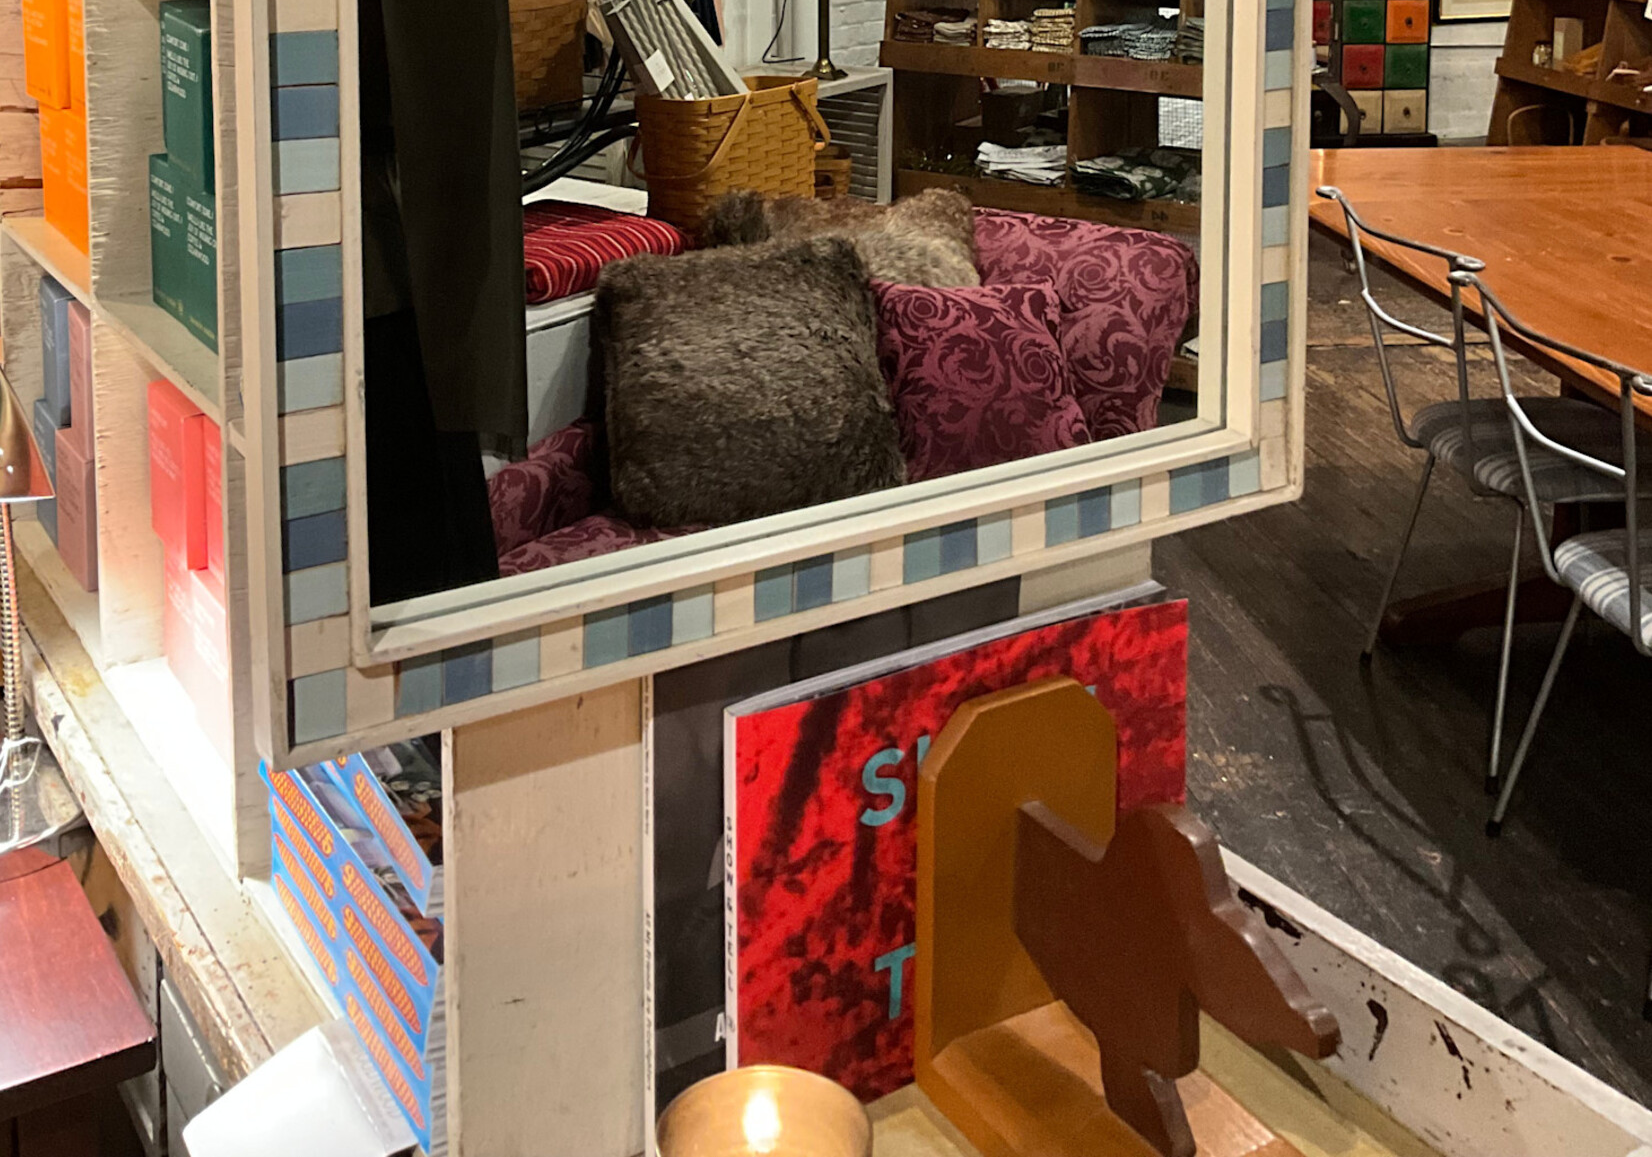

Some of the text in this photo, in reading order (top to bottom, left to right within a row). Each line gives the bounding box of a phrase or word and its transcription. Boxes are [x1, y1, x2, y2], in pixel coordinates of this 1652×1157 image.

[725, 816, 734, 993] SHOW & TELL
